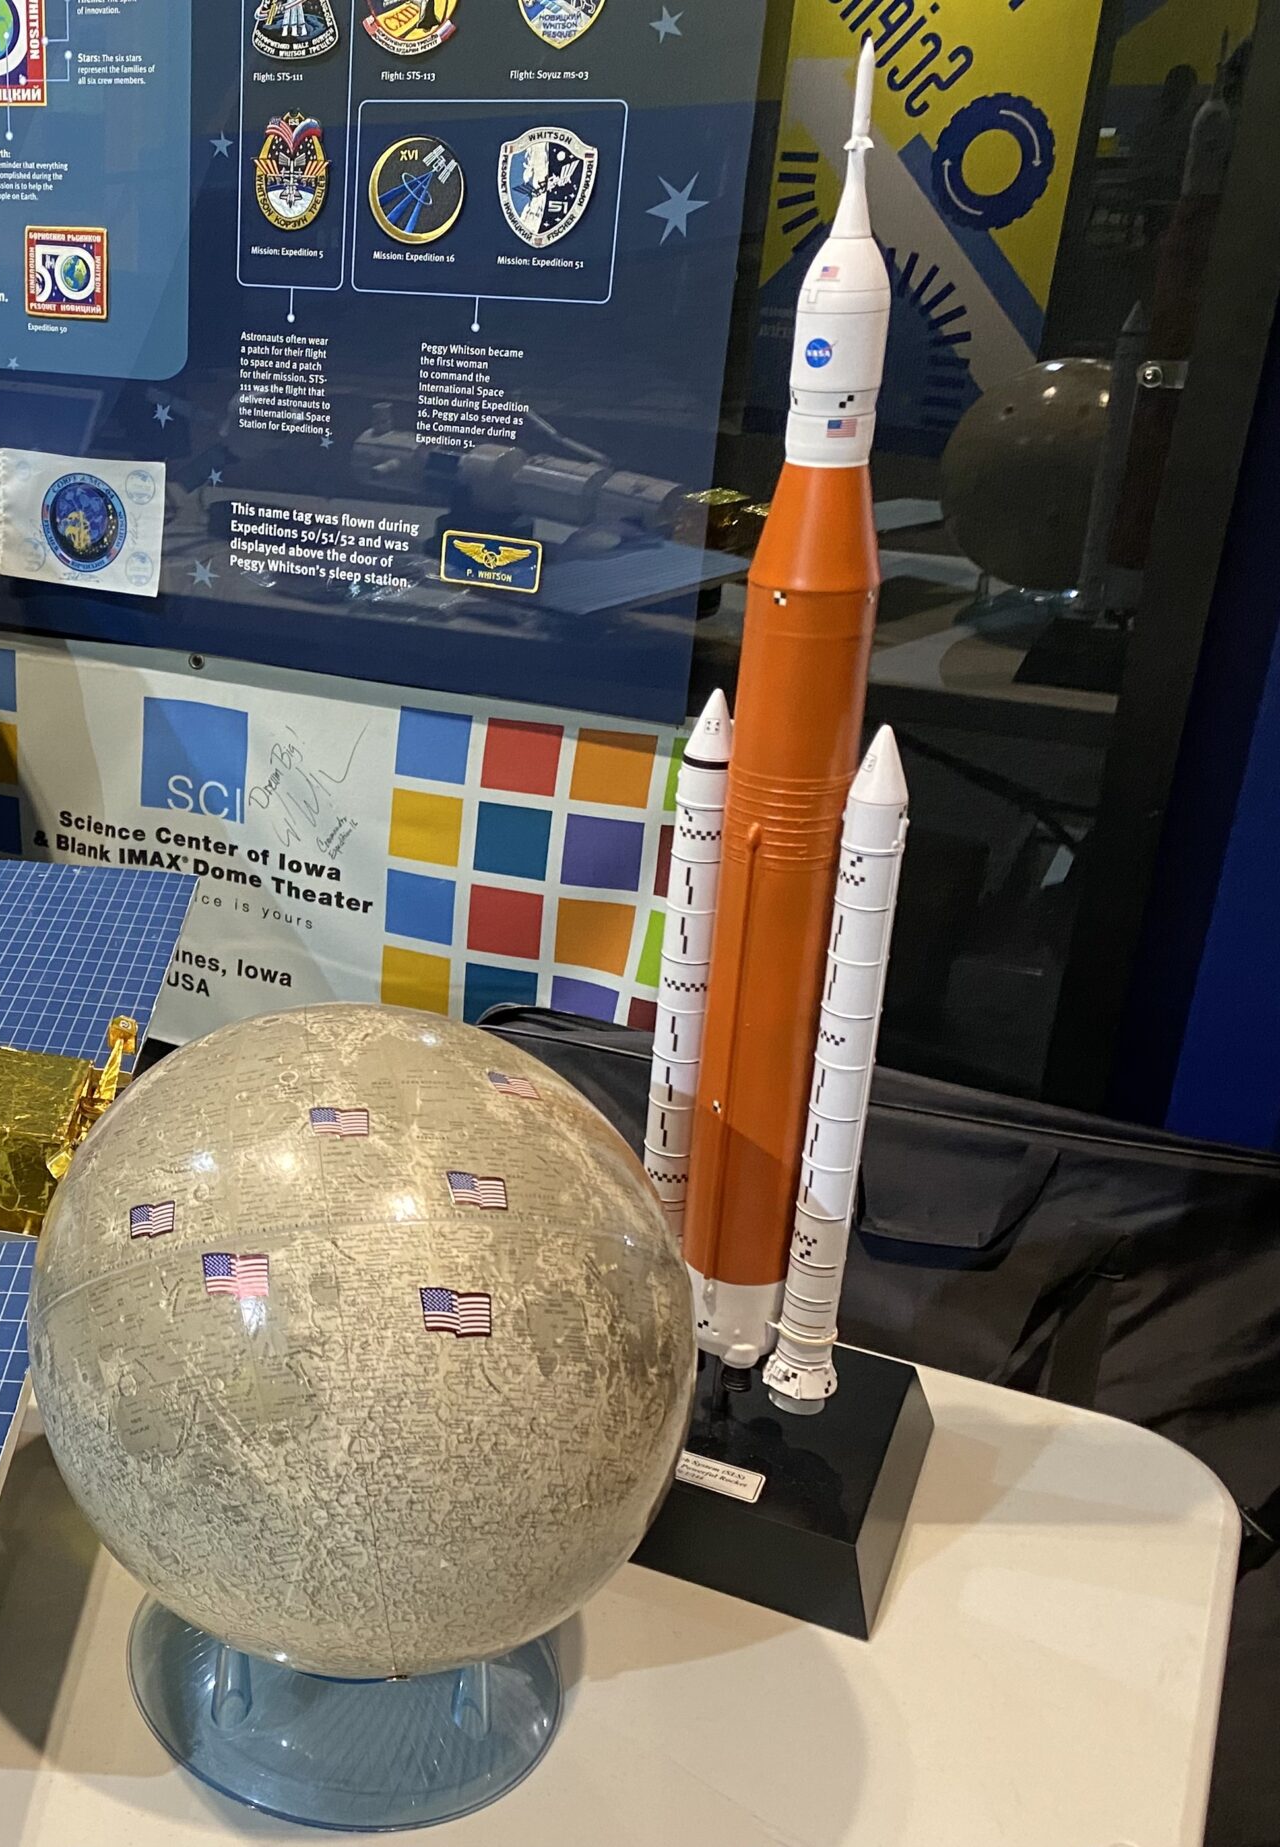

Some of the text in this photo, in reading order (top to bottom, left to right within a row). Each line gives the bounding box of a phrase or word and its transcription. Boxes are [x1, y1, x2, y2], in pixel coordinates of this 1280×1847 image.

[542, 22, 578, 31] WHITSON
[77, 53, 100, 62] Stars:
[253, 72, 303, 82] Flight: STS-111
[380, 71, 435, 81] Flight: STS-113
[510, 70, 588, 80] Flight: Soyuz ms-03
[528, 131, 573, 145] WHITSON
[399, 149, 420, 162] XVI
[548, 200, 569, 214] 51
[546, 214, 577, 242] FISCHER
[250, 246, 323, 258] Mission: Expedition 5
[372, 251, 455, 262] Mission: Expedition 16
[497, 256, 583, 269] Mission: Expedition 51
[27, 322, 58, 331] Expedition
[240, 331, 284, 342] Astronauts
[285, 334, 306, 344] often
[247, 345, 269, 354] patch
[271, 345, 283, 355] for
[284, 346, 303, 356] their
[304, 348, 326, 359] flight
[421, 342, 524, 358] Peggy Whitson became
[420, 355, 488, 368] the first woman
[419, 369, 490, 382] to command the
[418, 382, 504, 397] International Space
[418, 394, 529, 412] Station during Expedition
[230, 502, 419, 536] This name tag was flown during
[230, 520, 409, 551] Expeditions 50/51/52 and was
[230, 538, 393, 567] displayed above the door of
[230, 554, 265, 573] Peggy
[328, 566, 361, 584] sleep
[364, 572, 412, 589] station.
[466, 568, 512, 582] P. WHITSON
[166, 775, 246, 824] SCI
[59, 811, 340, 880] Science Center of Iowa
[33, 829, 51, 848] &
[56, 834, 110, 862] Blank
[193, 859, 262, 888] Dome
[271, 877, 373, 912] Theater
[234, 898, 249, 912] is
[261, 907, 312, 929] yours
[237, 959, 291, 986] Iowa
[167, 971, 210, 998] USA
